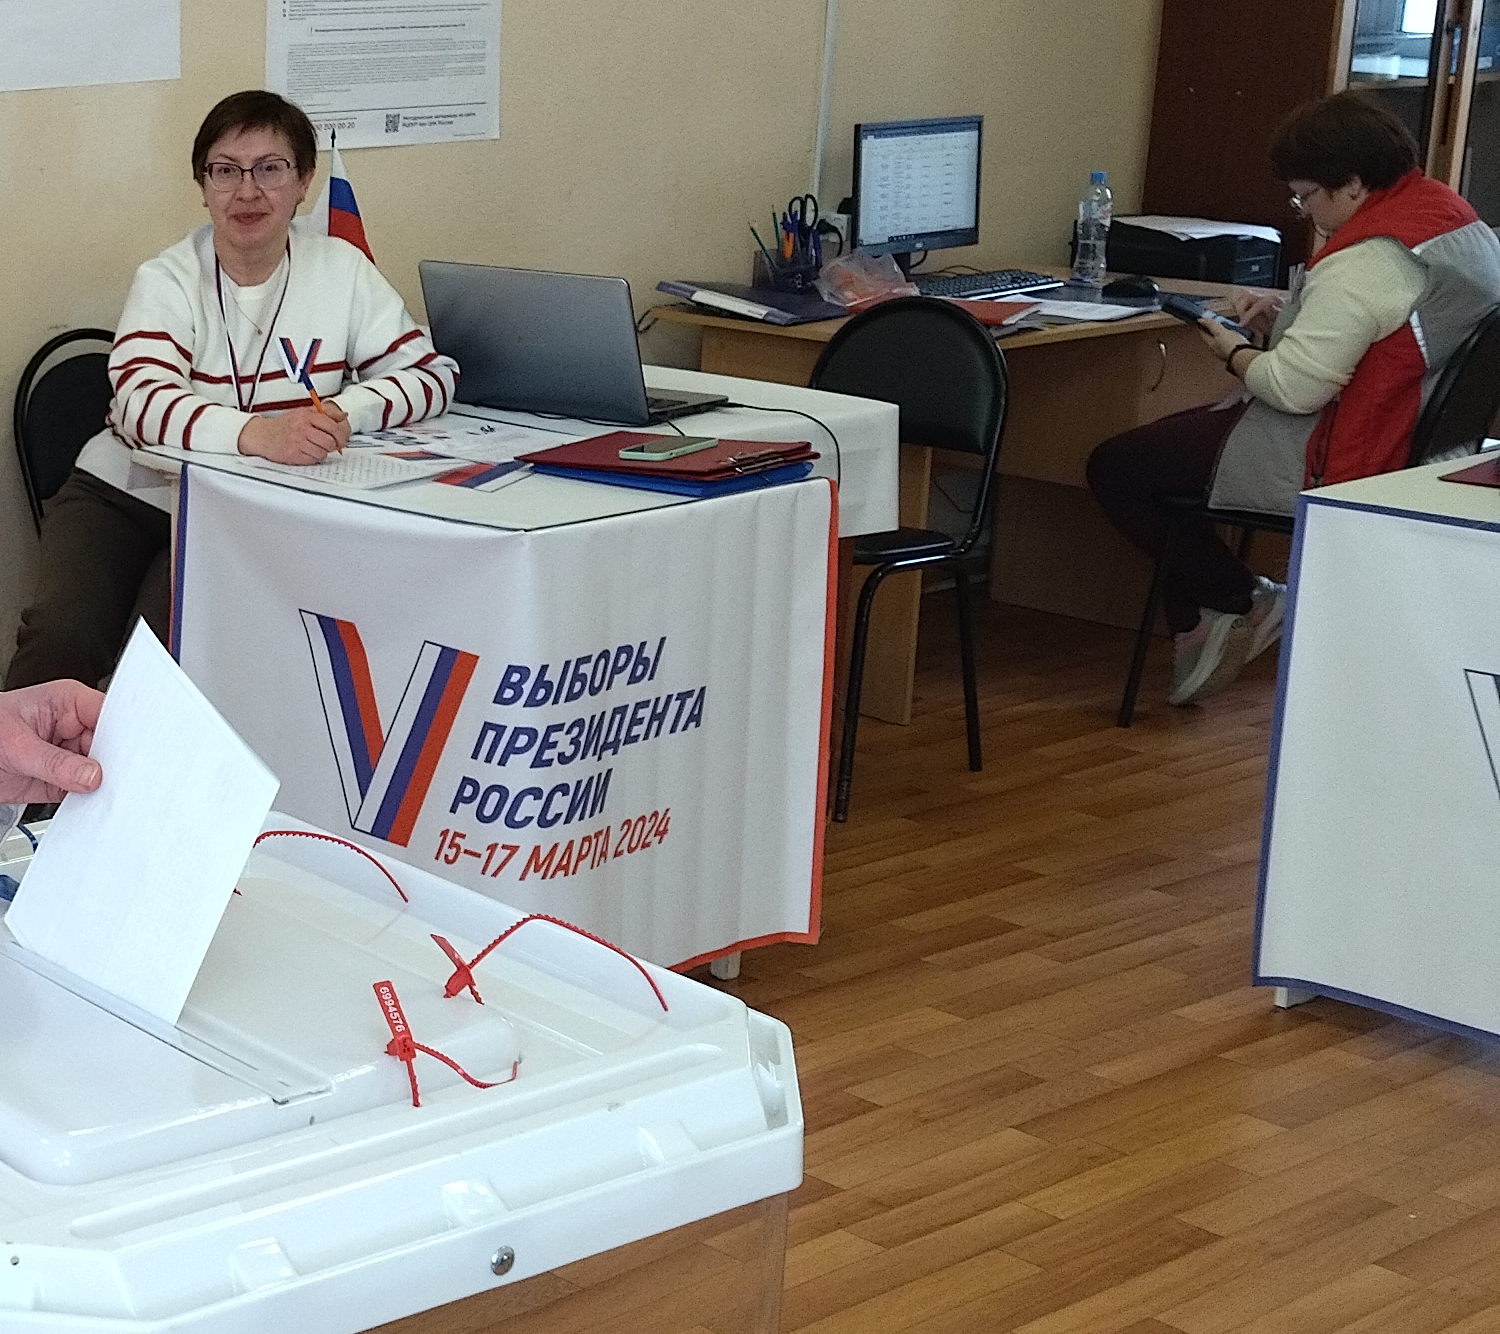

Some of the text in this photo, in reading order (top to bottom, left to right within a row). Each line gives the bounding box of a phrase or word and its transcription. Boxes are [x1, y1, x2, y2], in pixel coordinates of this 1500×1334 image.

[492, 636, 668, 708] ВЫБОРЫ
[470, 686, 707, 769] ПРЕЗИДЕНТА
[449, 768, 614, 829] РОССИИ
[519, 825, 611, 882] МАРТА
[612, 807, 671, 859] 2024
[379, 986, 406, 1033] 6994576
